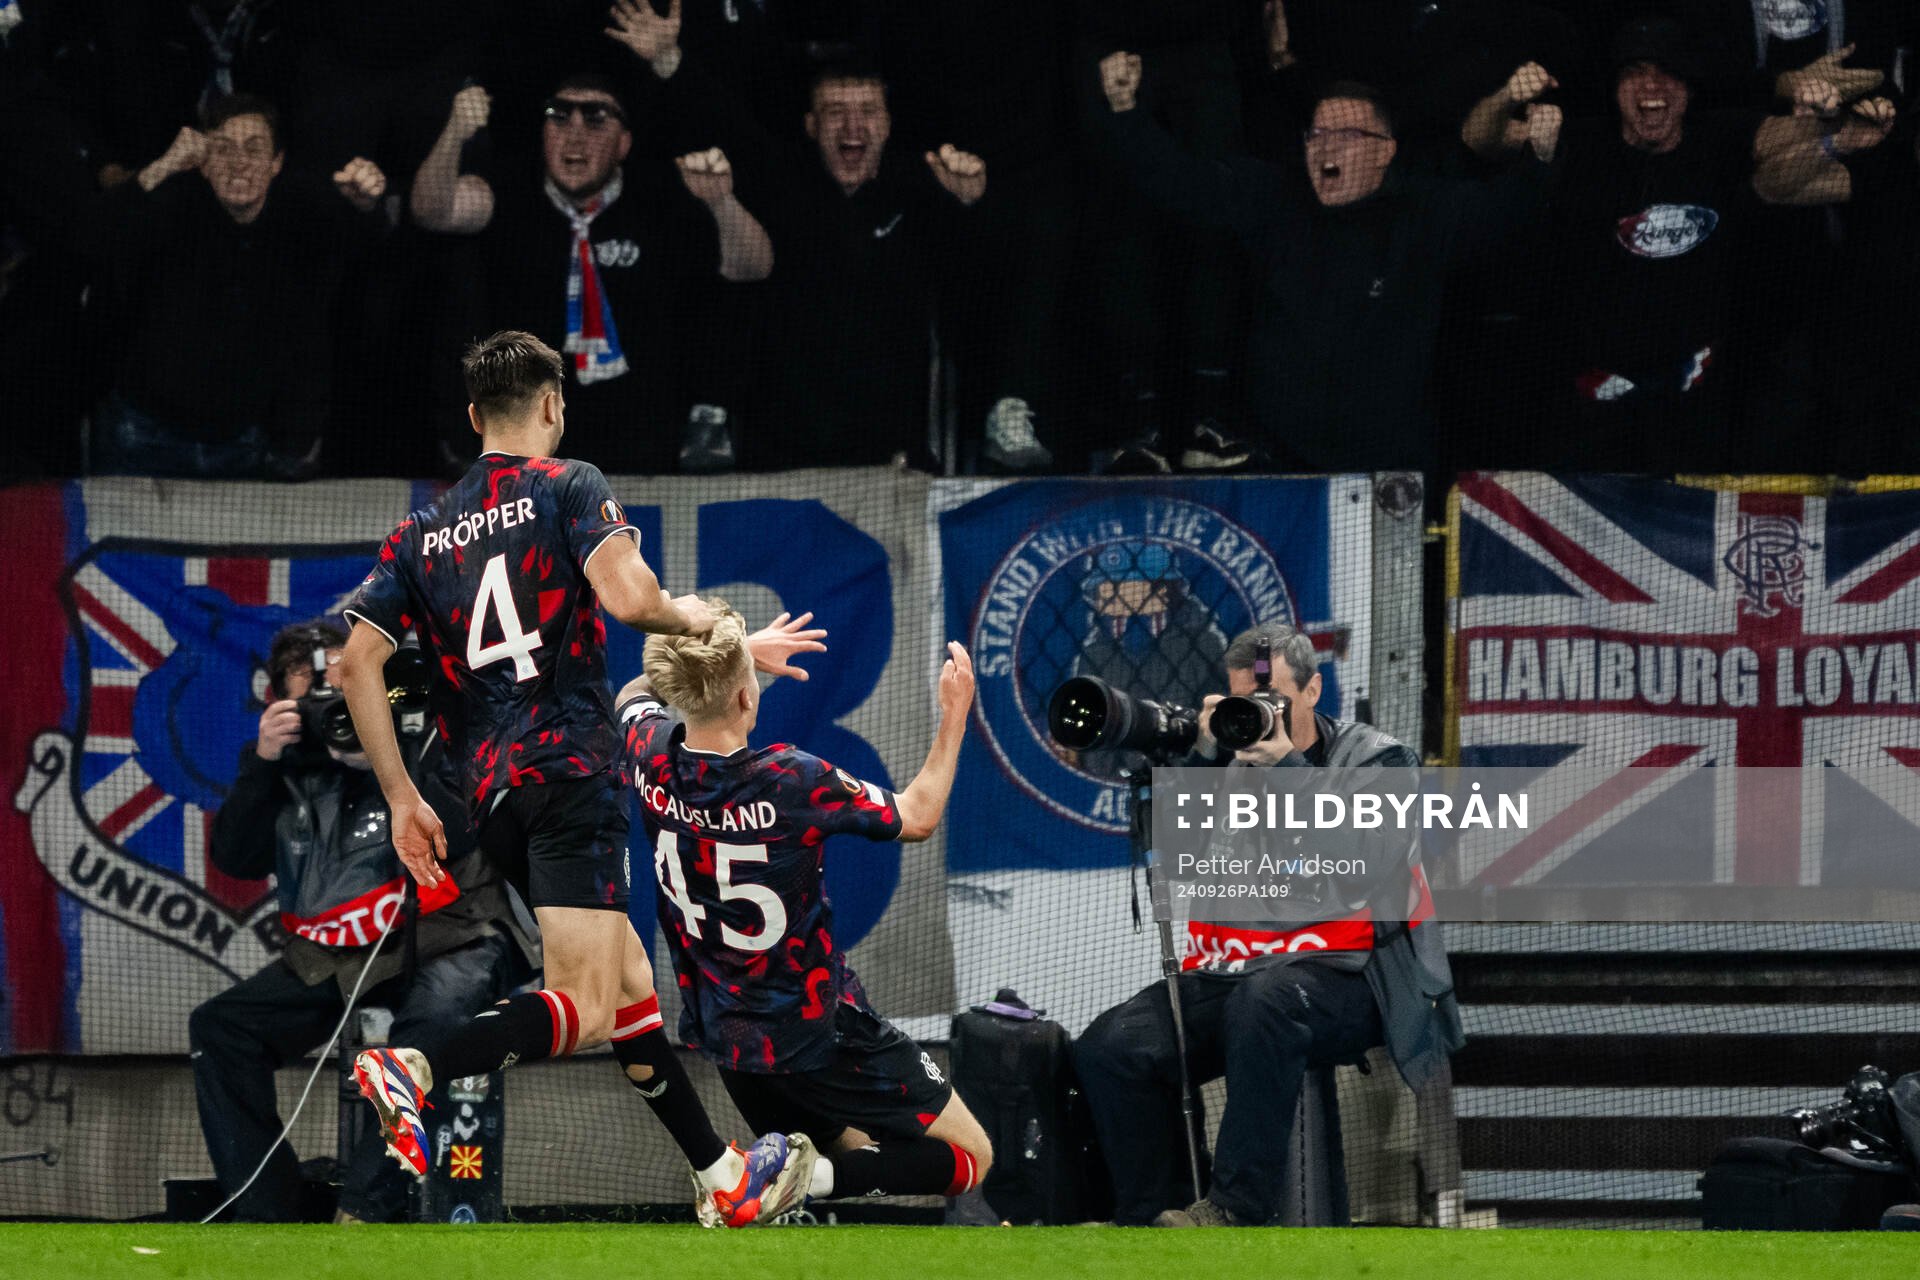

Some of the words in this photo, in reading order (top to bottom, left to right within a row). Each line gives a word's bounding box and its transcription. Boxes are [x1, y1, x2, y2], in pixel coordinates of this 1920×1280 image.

[422, 497, 537, 557] PRÖPPER
[466, 552, 544, 683] 4
[980, 557, 1040, 677] STAND
[1209, 527, 1291, 627] BANN
[1468, 638, 1760, 707] HAMBURG
[1776, 641, 1920, 708] LOYA
[69, 843, 235, 957] UNION
[654, 829, 788, 951] 45
[4, 1064, 74, 1127] 84
